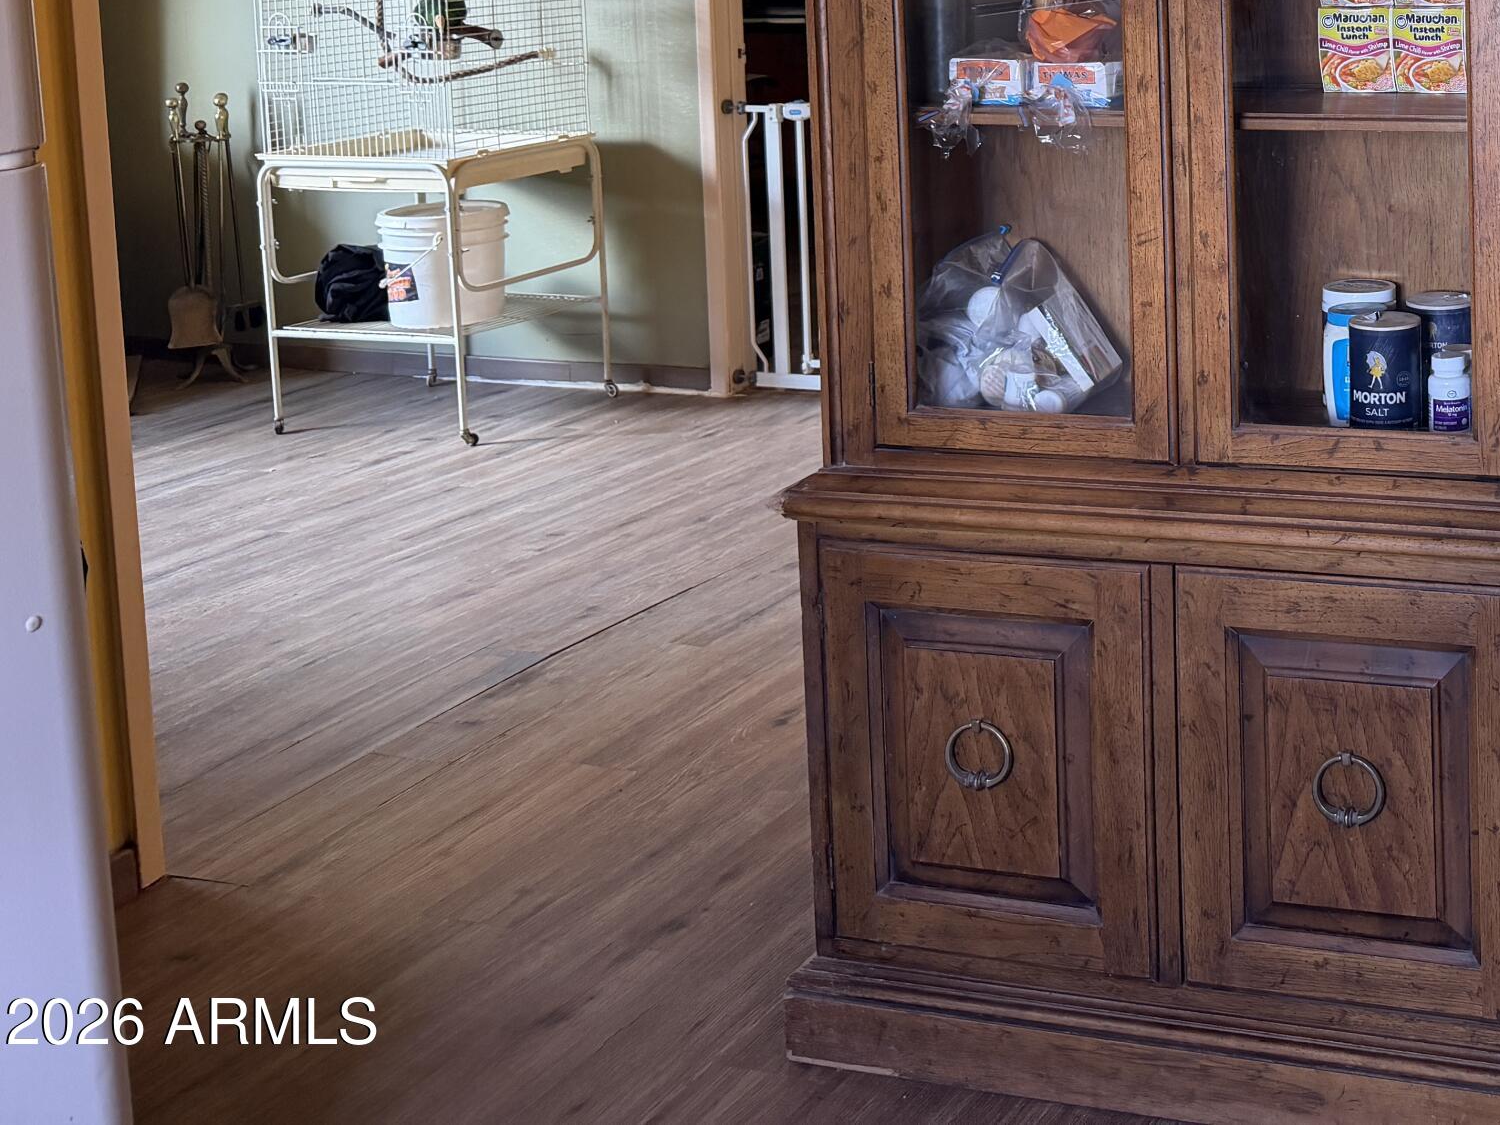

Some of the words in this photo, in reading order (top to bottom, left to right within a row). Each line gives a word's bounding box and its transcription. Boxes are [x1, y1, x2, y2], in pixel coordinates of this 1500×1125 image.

[1332, 13, 1385, 23] Maruchan
[1405, 13, 1457, 24] Maruchan
[1336, 25, 1372, 33] Instant
[1410, 25, 1445, 33] Instant
[1341, 32, 1369, 40] Lunch
[1413, 33, 1441, 41] Lunch
[1042, 71, 1088, 79] THMAS
[1353, 389, 1406, 405] MORTON
[1365, 407, 1390, 416] SALT
[1435, 404, 1468, 413] Melatonin
